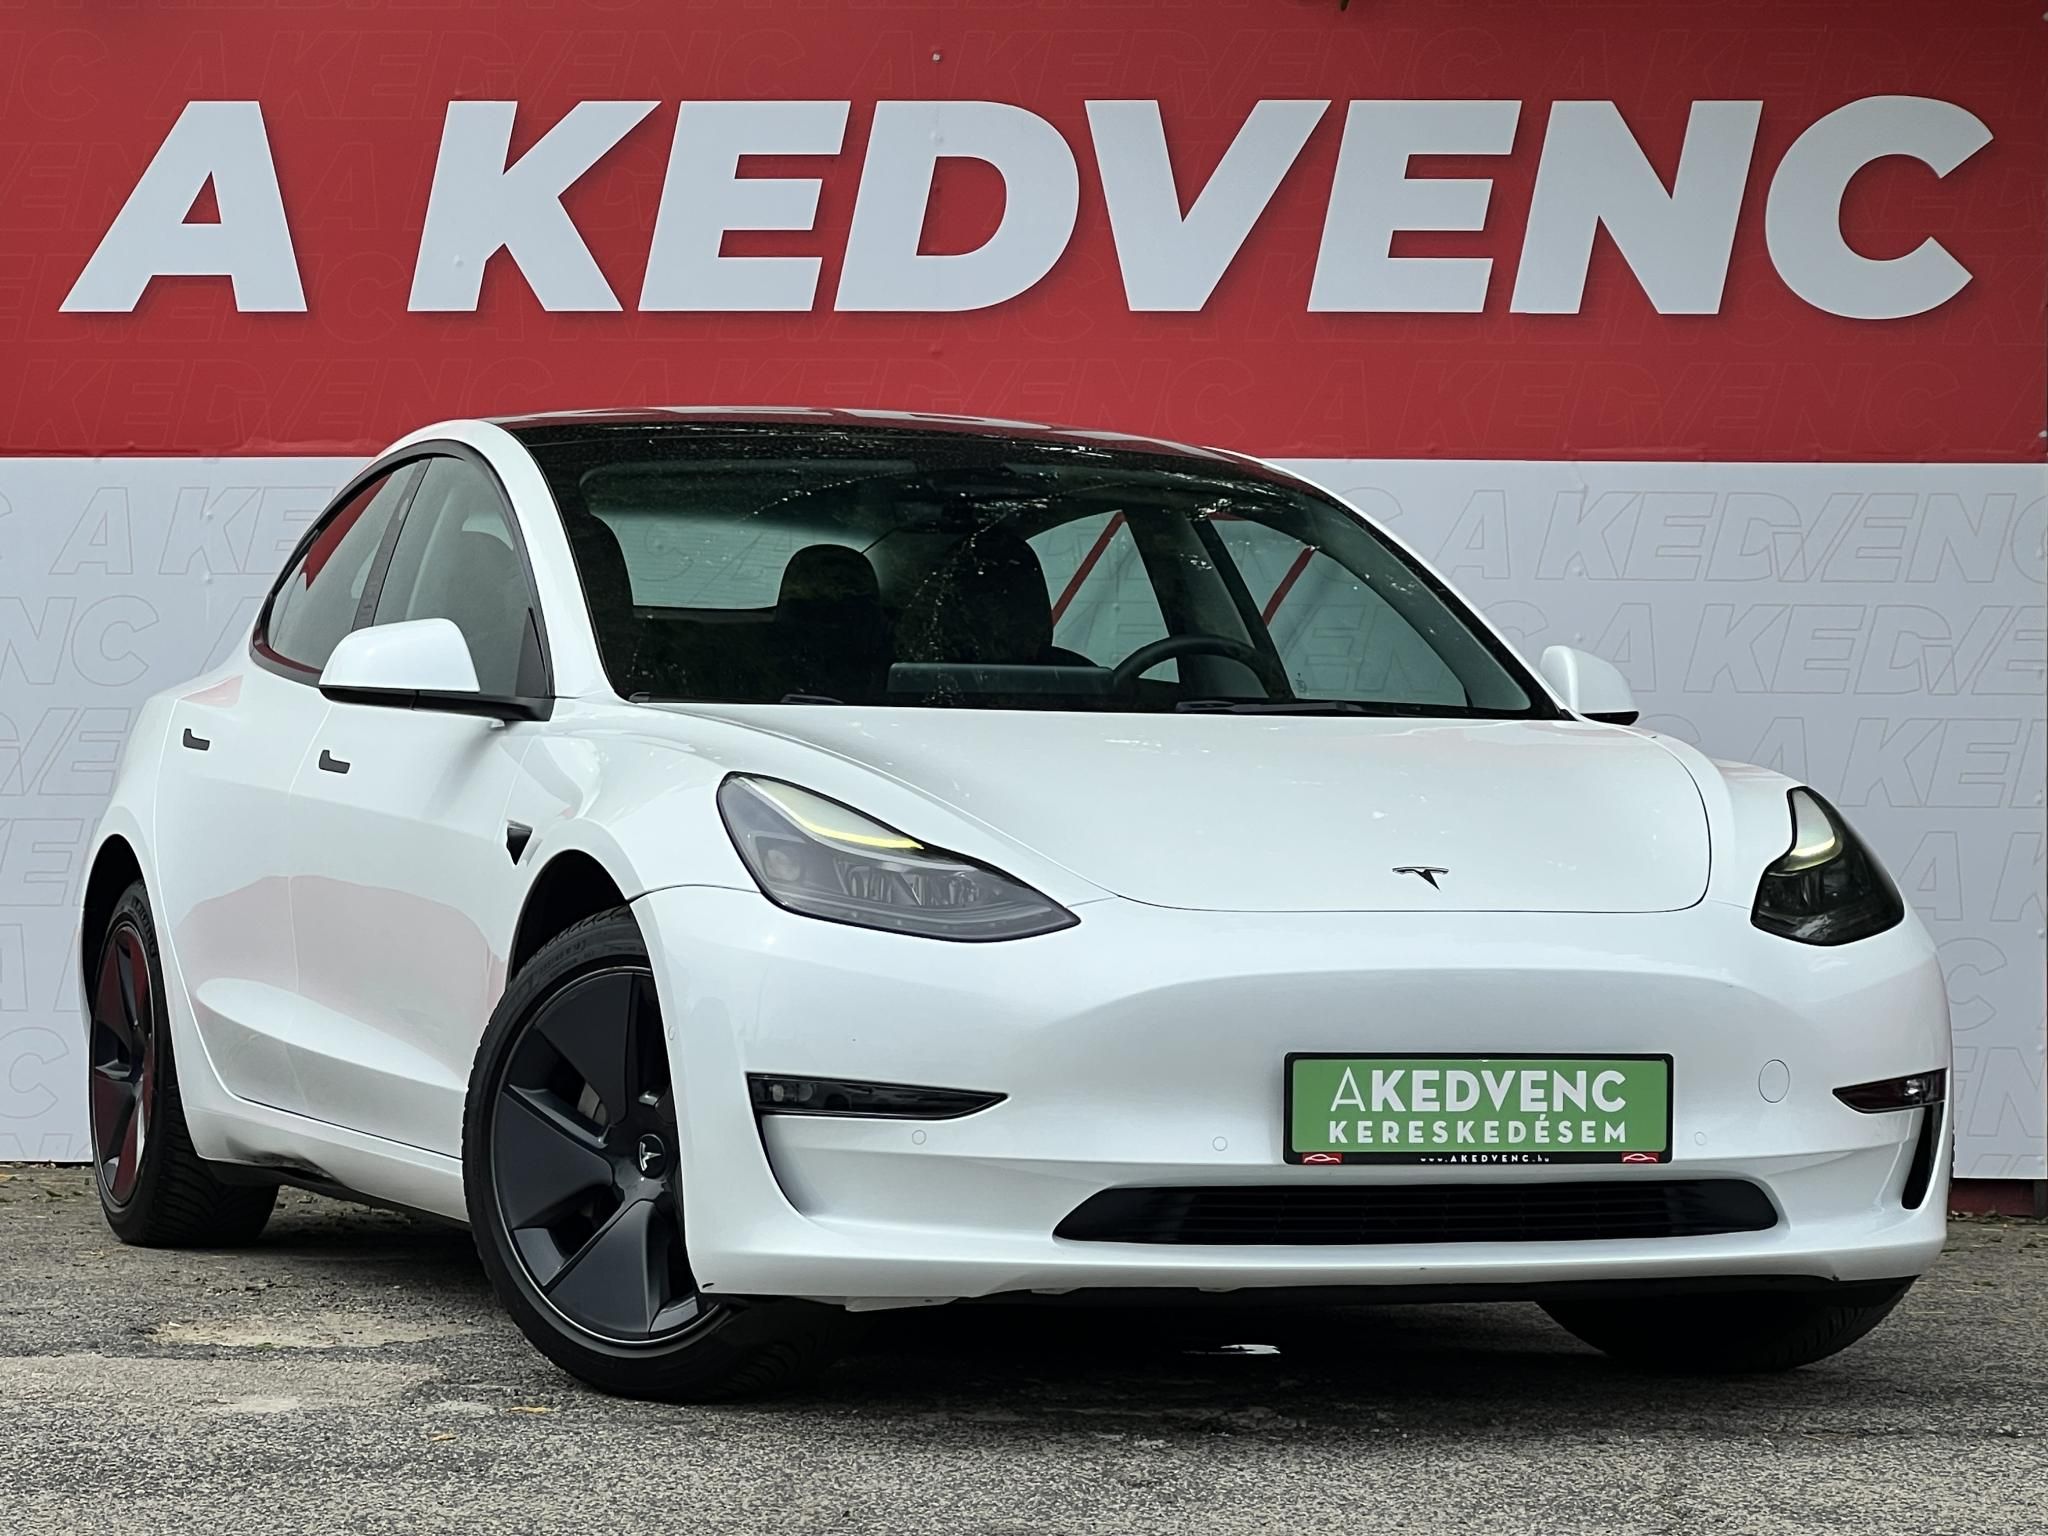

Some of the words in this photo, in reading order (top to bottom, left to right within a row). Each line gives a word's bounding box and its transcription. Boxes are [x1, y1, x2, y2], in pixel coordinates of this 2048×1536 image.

[58, 100, 307, 313] A
[407, 94, 1995, 320] KEDVENC
[1329, 1114, 1626, 1144] KERESKEDÉSEM
